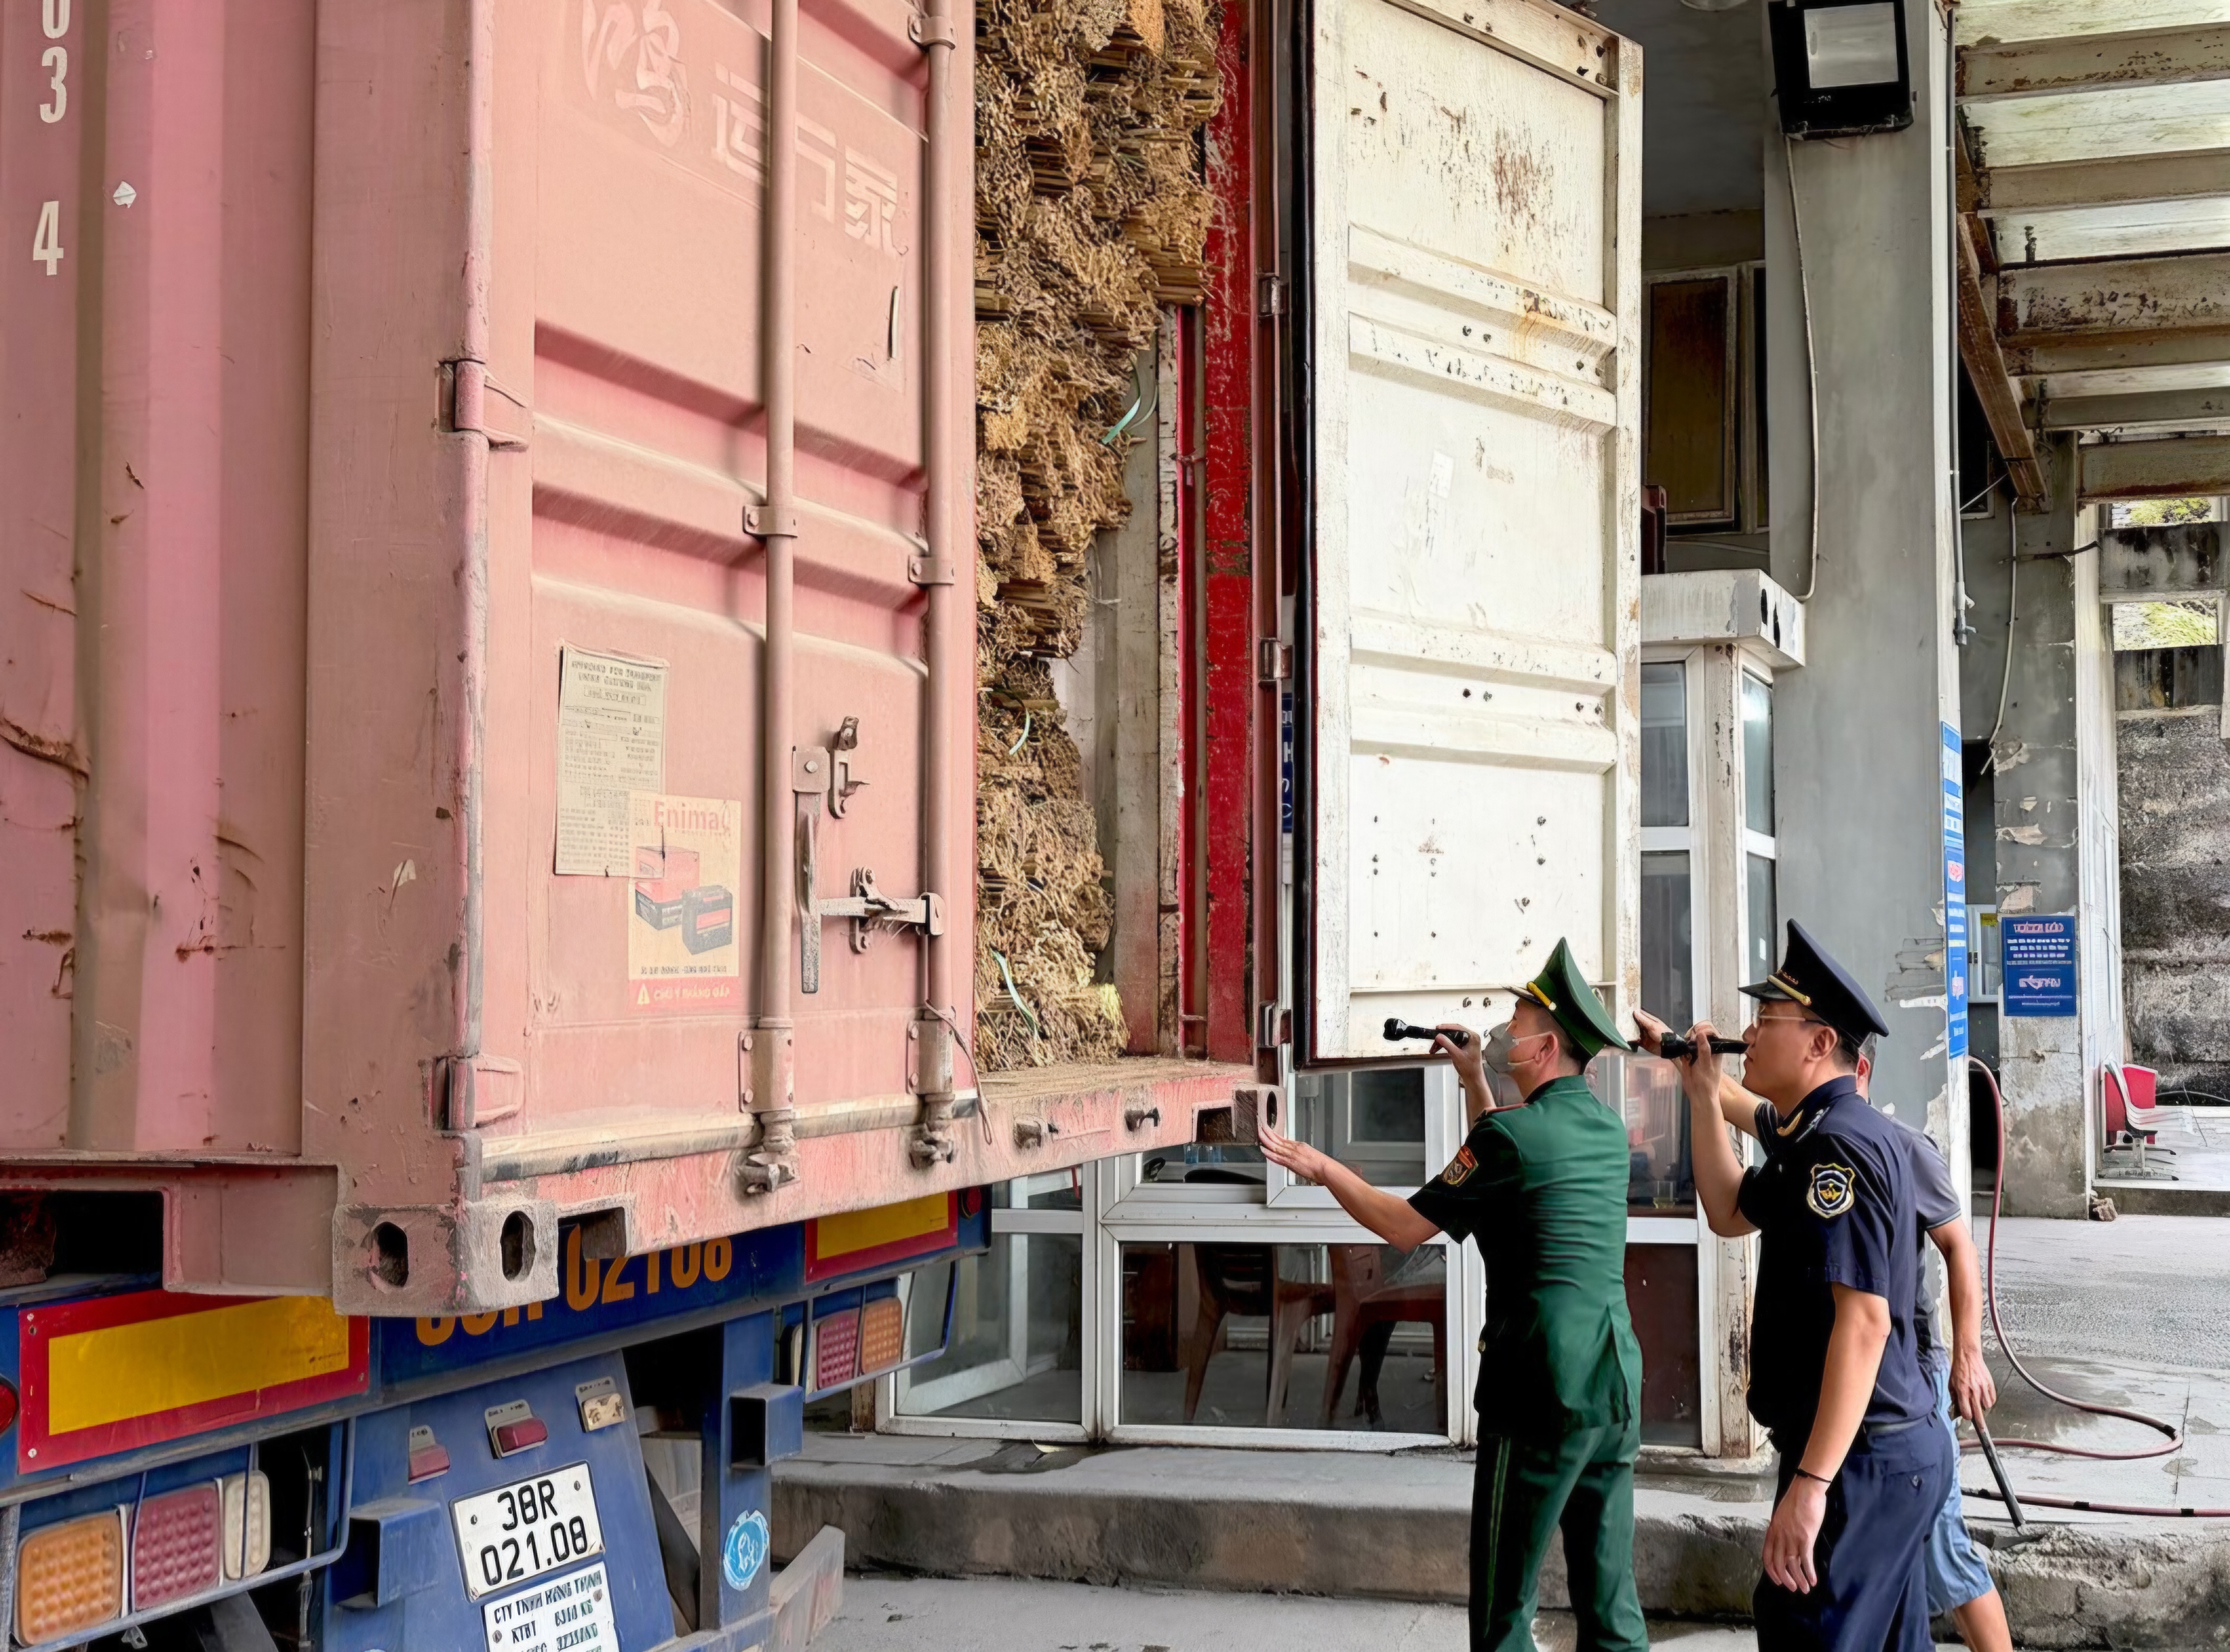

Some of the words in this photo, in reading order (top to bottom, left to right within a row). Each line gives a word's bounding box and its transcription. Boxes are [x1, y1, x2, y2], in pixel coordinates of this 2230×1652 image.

[33, 201, 64, 276] 4
[497, 1479, 558, 1531] 38R
[481, 1516, 588, 1586] 021.08
